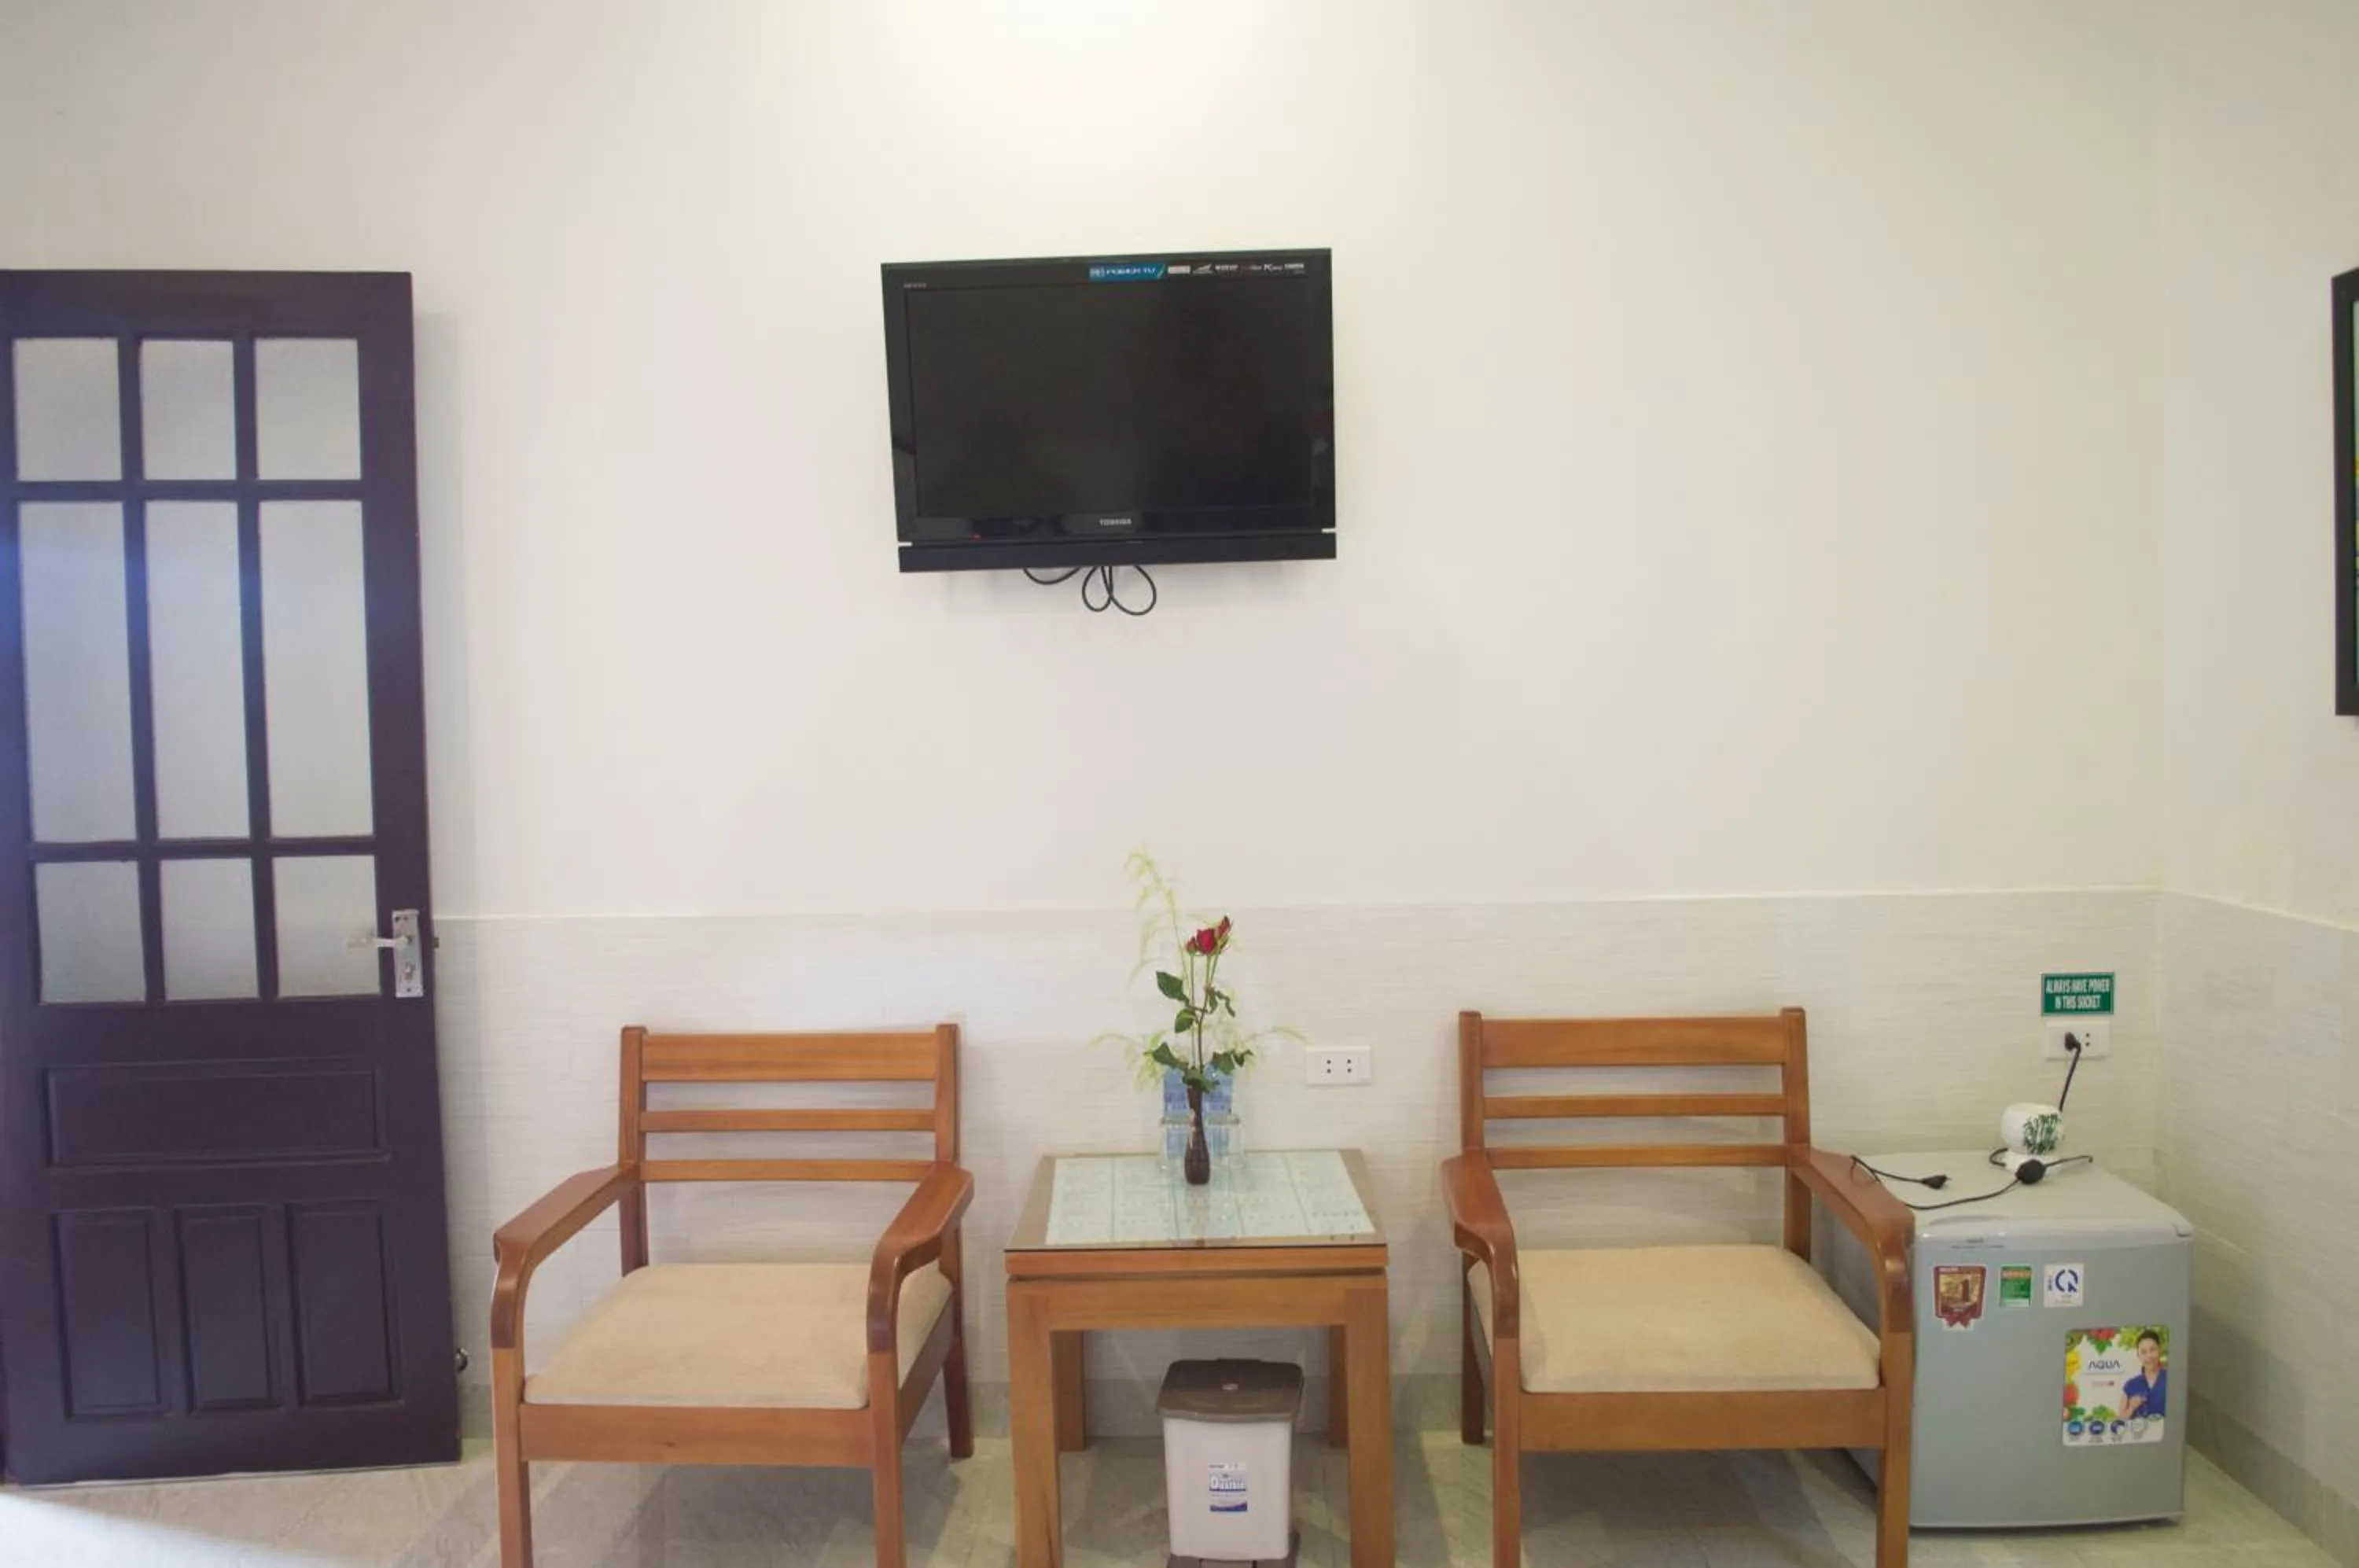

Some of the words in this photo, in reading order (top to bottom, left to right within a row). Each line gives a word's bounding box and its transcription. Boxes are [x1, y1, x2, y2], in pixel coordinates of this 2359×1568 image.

[2046, 978, 2070, 994] ALWAYS
[2071, 978, 2087, 993] HAVE
[2089, 977, 2110, 992] POWER
[2055, 995, 2061, 1010] IN
[2063, 995, 2076, 1010] THIS
[2077, 994, 2101, 1009] SOCKET
[2089, 1359, 2121, 1370] AQUA
